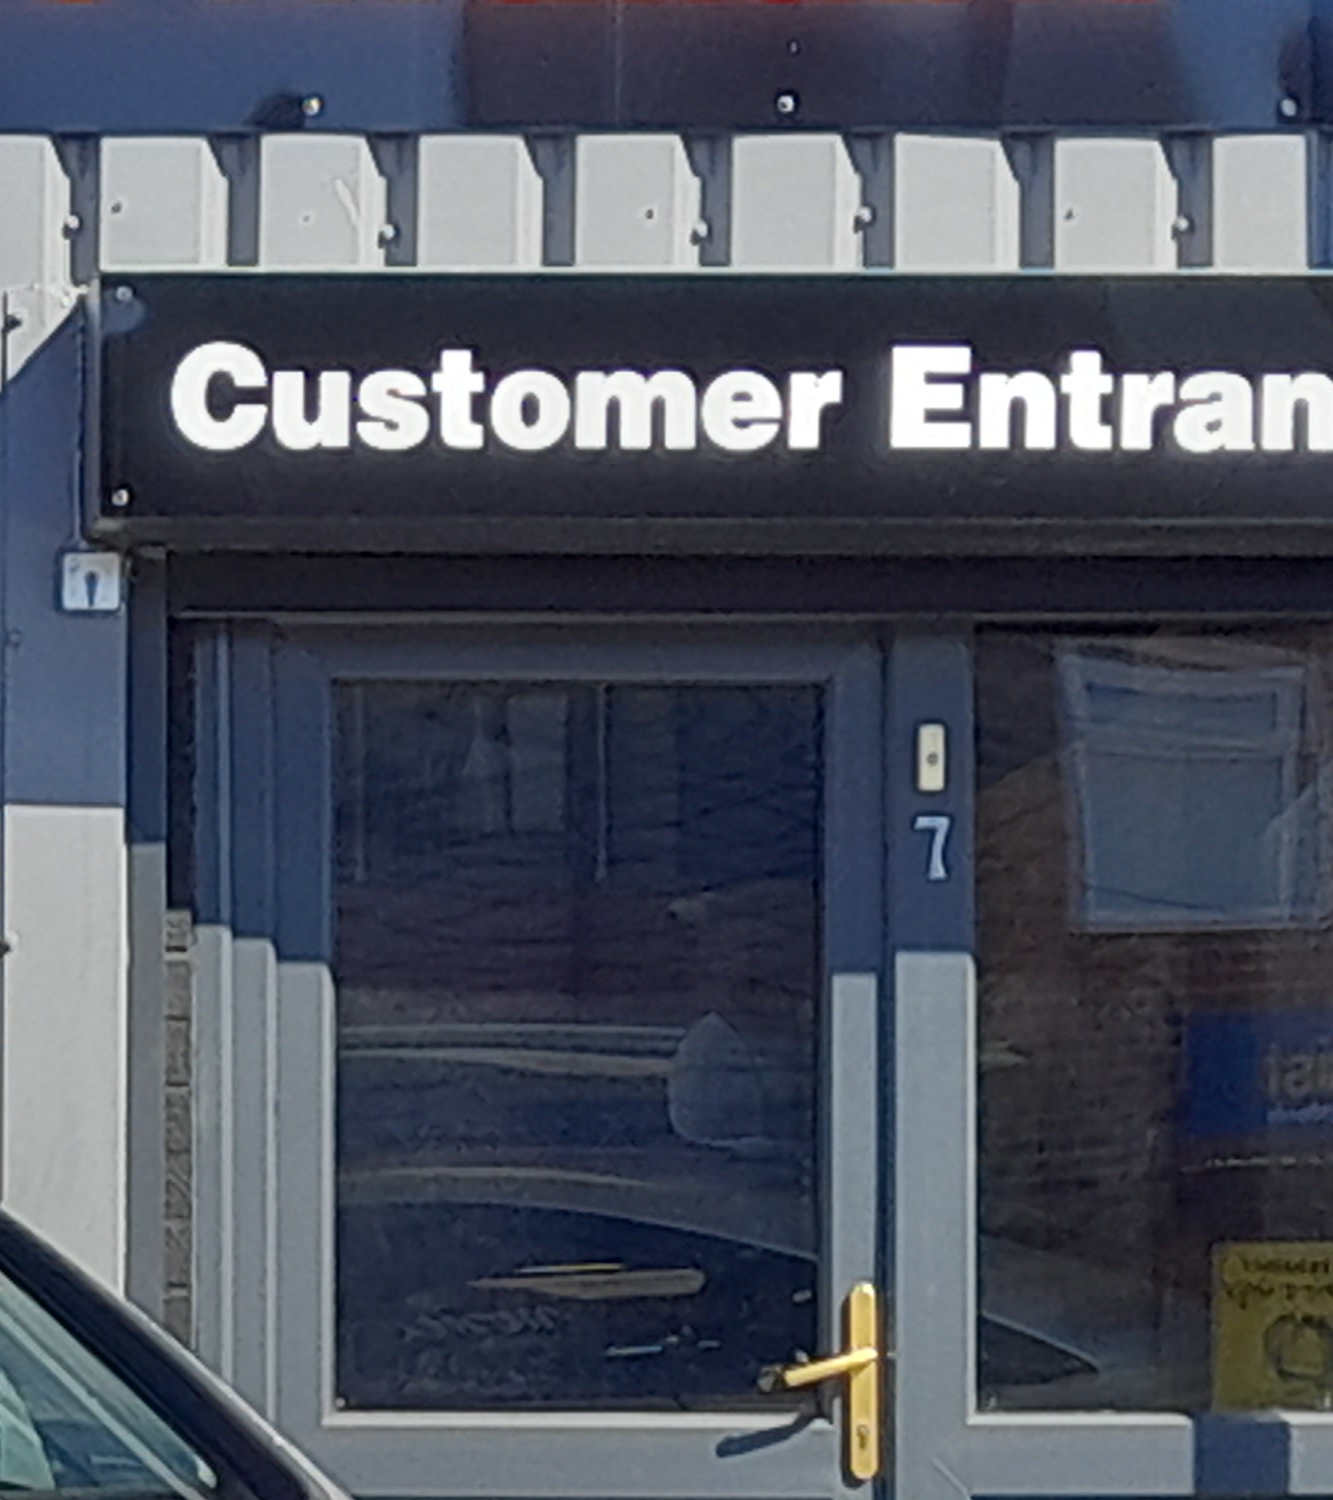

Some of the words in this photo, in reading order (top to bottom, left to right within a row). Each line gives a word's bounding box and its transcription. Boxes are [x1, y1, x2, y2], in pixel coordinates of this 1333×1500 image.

[171, 342, 842, 451] Customer
[890, 344, 1333, 452] Entran
[914, 814, 950, 881] 7
